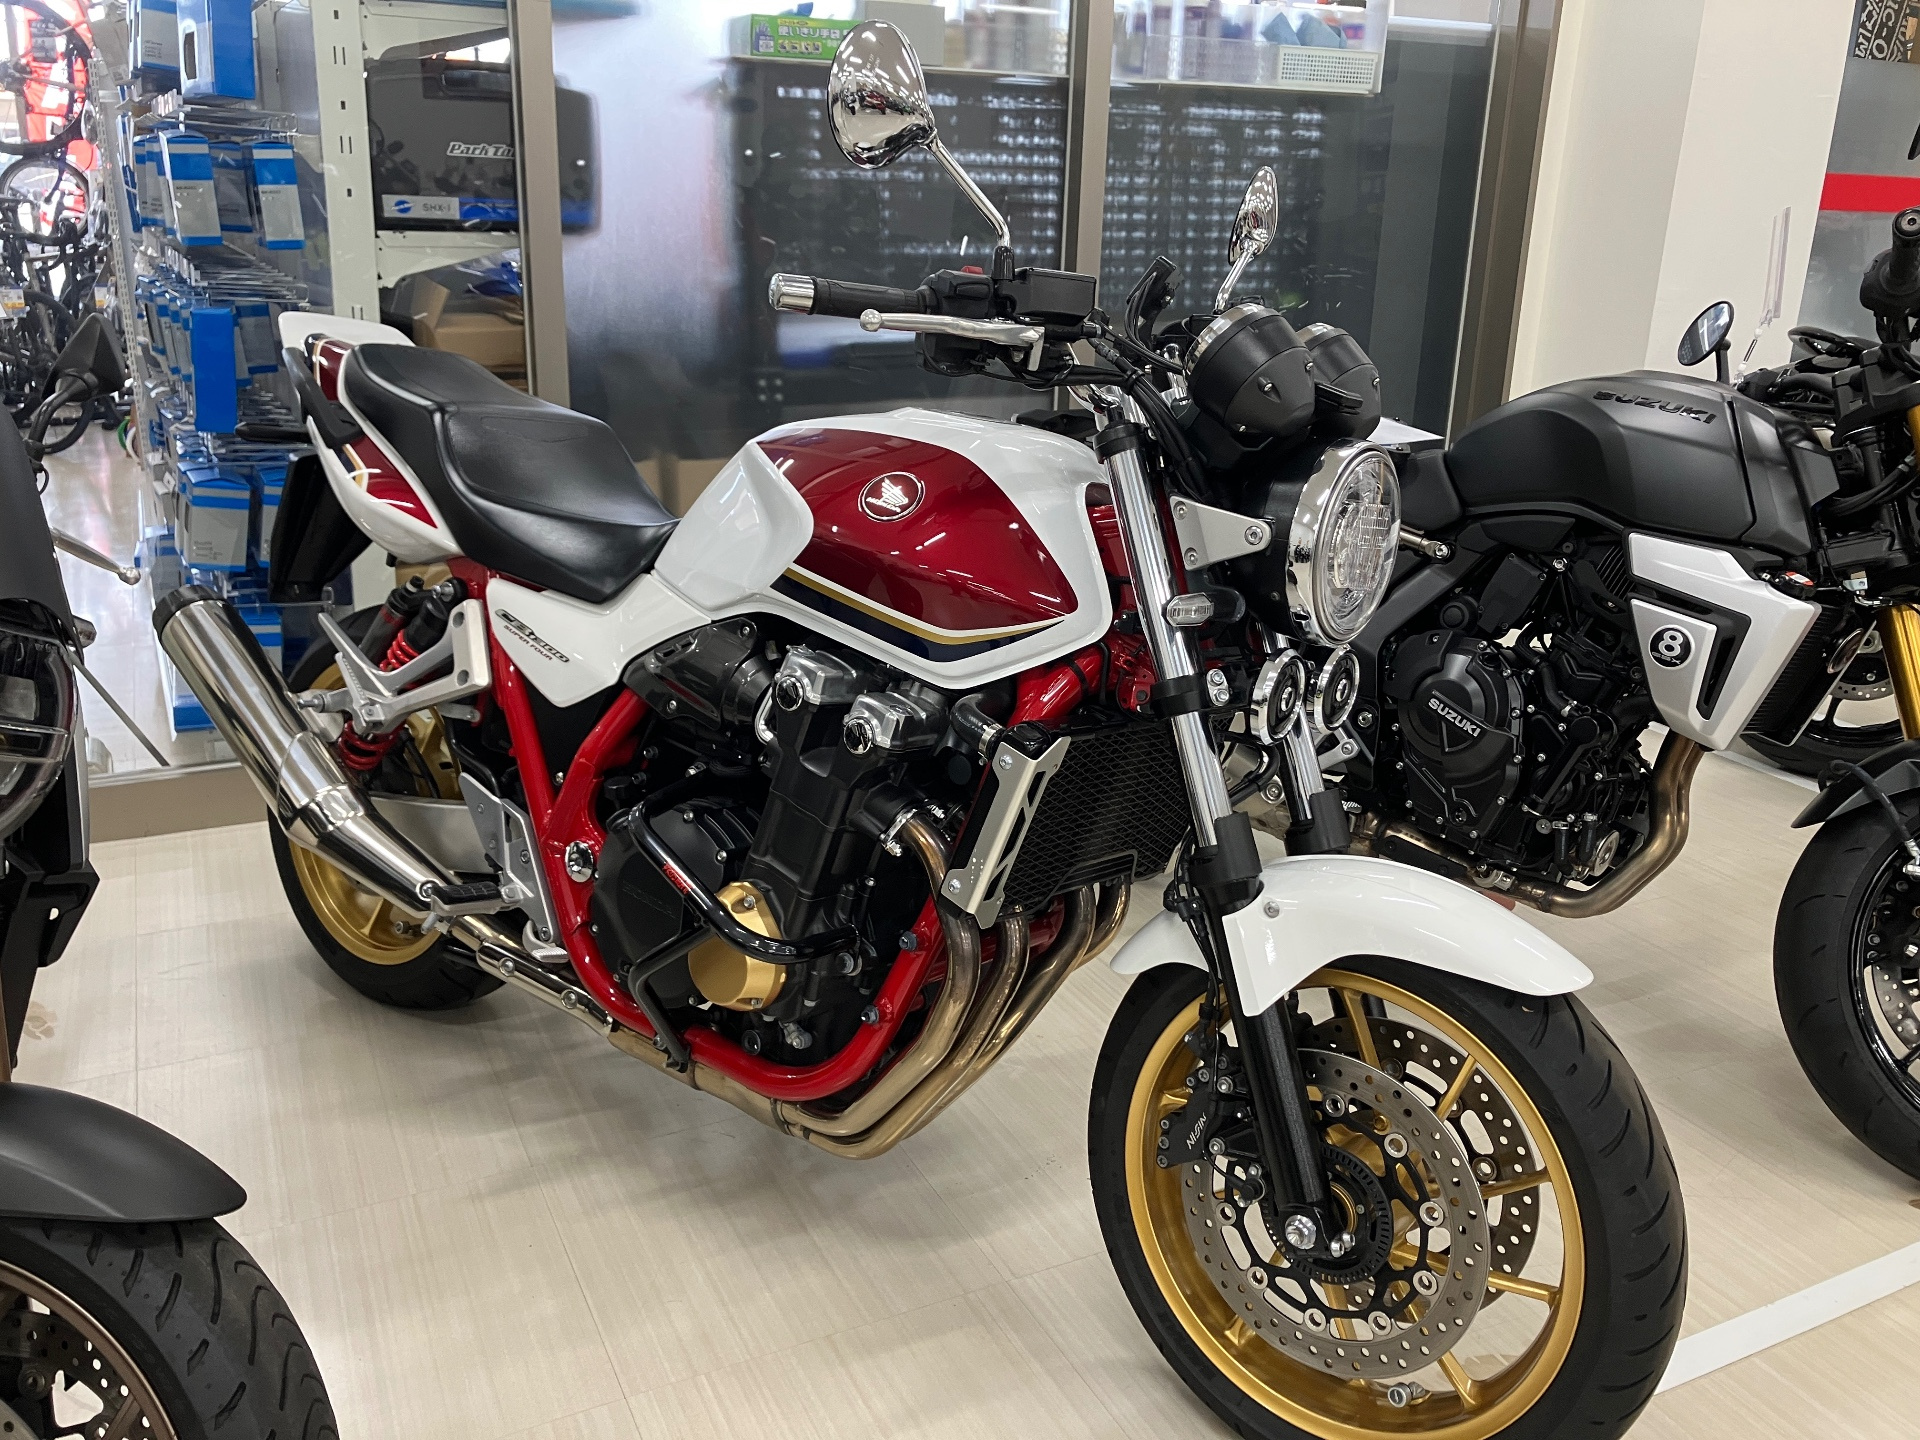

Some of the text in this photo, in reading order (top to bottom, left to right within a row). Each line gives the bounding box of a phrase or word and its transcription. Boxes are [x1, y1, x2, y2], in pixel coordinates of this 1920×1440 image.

[1592, 390, 1717, 425] SUZUKI
[503, 624, 554, 662] SUPER FOUR
[1658, 630, 1684, 657] 8
[1428, 698, 1481, 737] SUZUKI
